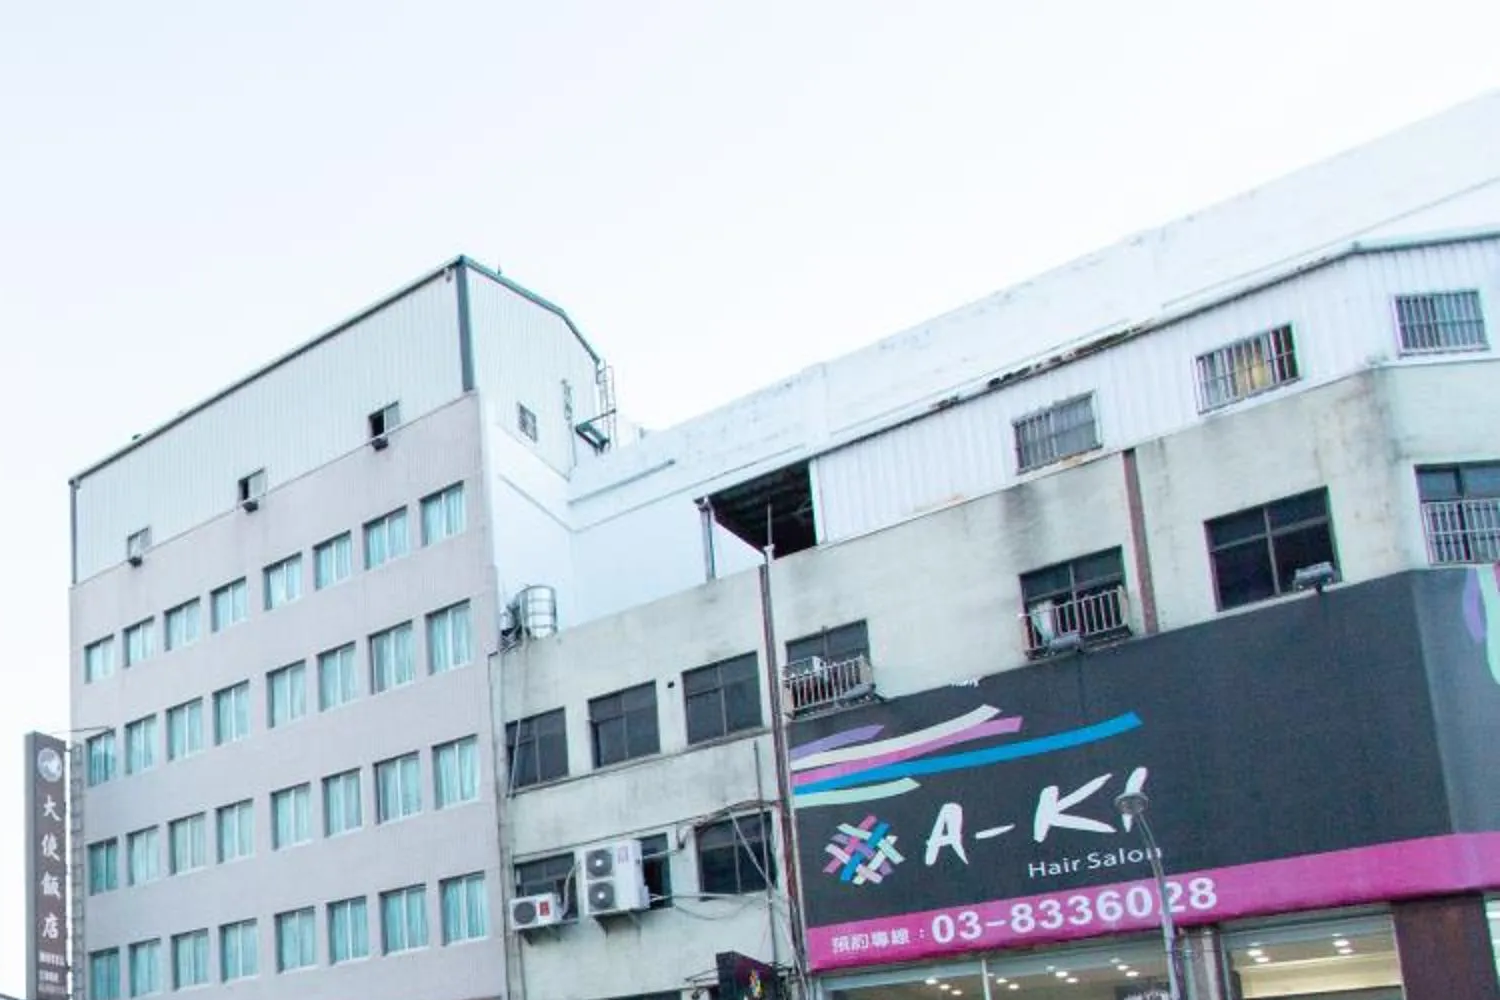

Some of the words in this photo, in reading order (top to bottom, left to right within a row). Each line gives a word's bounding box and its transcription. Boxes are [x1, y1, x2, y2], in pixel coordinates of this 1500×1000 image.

[1028, 856, 1082, 878] Hair
[1087, 847, 1163, 870] Salon
[931, 876, 1218, 946] 03-8336028
